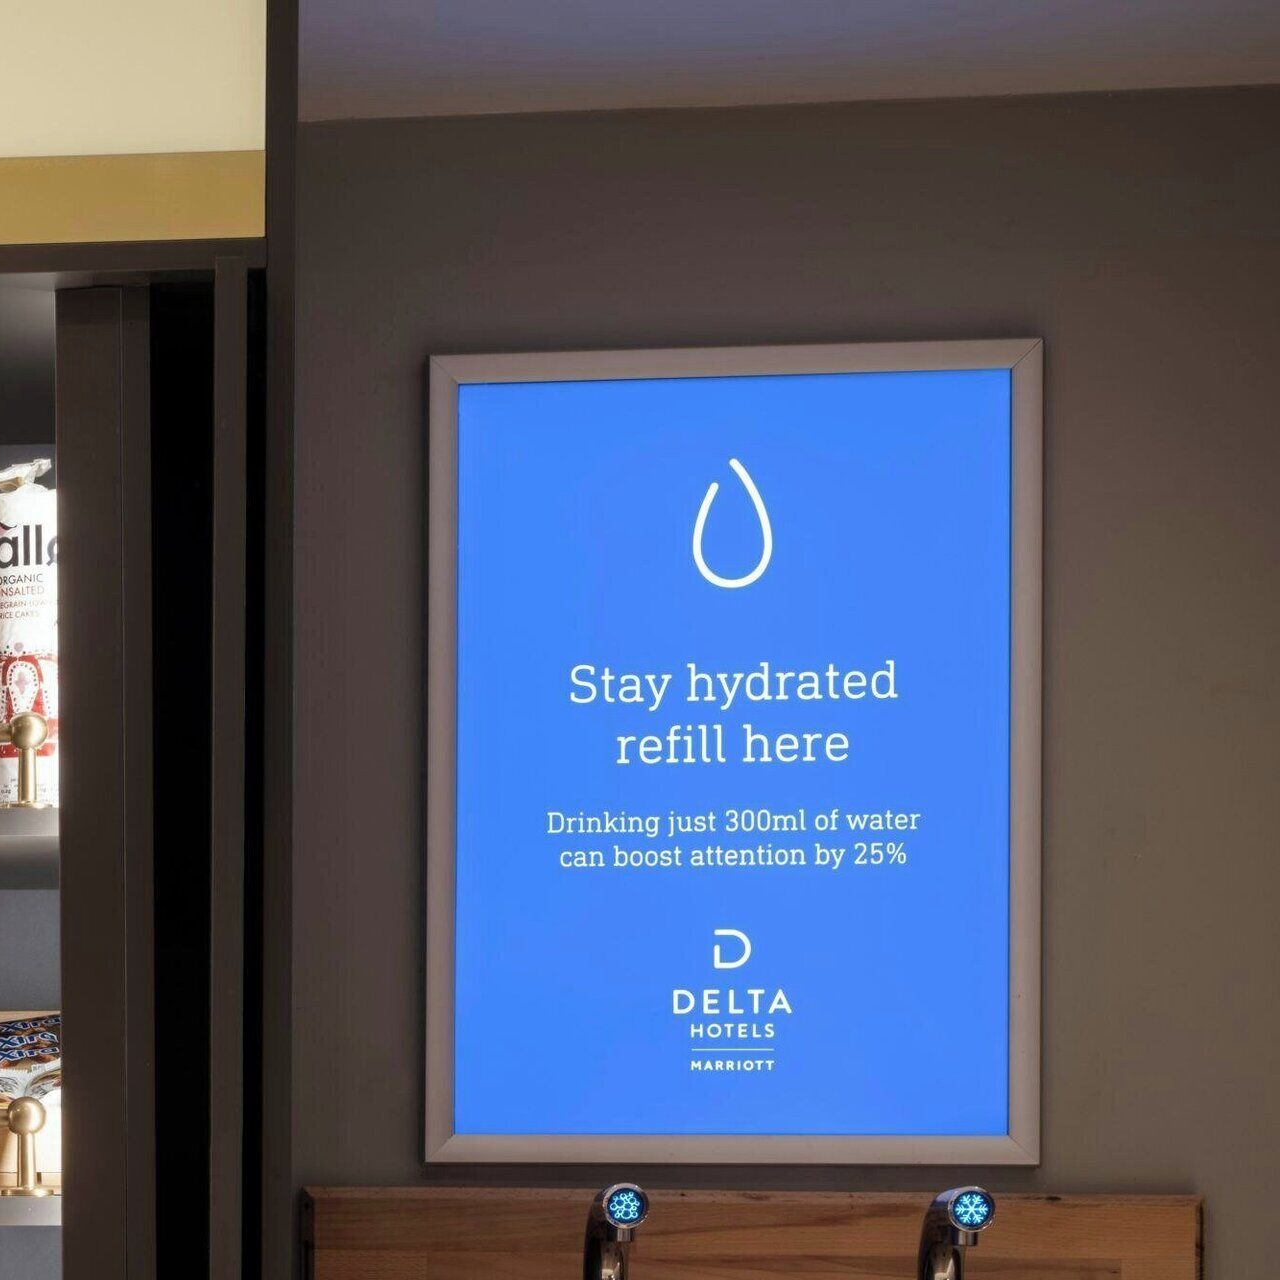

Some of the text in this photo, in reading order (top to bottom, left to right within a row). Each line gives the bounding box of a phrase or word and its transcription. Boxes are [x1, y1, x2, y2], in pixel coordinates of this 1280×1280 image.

[570, 660, 898, 711] Stay hydrated
[616, 724, 849, 764] refill here
[547, 809, 921, 837] Drinking just 300ml of water
[560, 842, 907, 869] can boost attention by 25%
[714, 929, 751, 969] D
[673, 989, 792, 1014] DELTA
[691, 1024, 775, 1038] HOTELS
[691, 1061, 775, 1071] MARRIOTT
